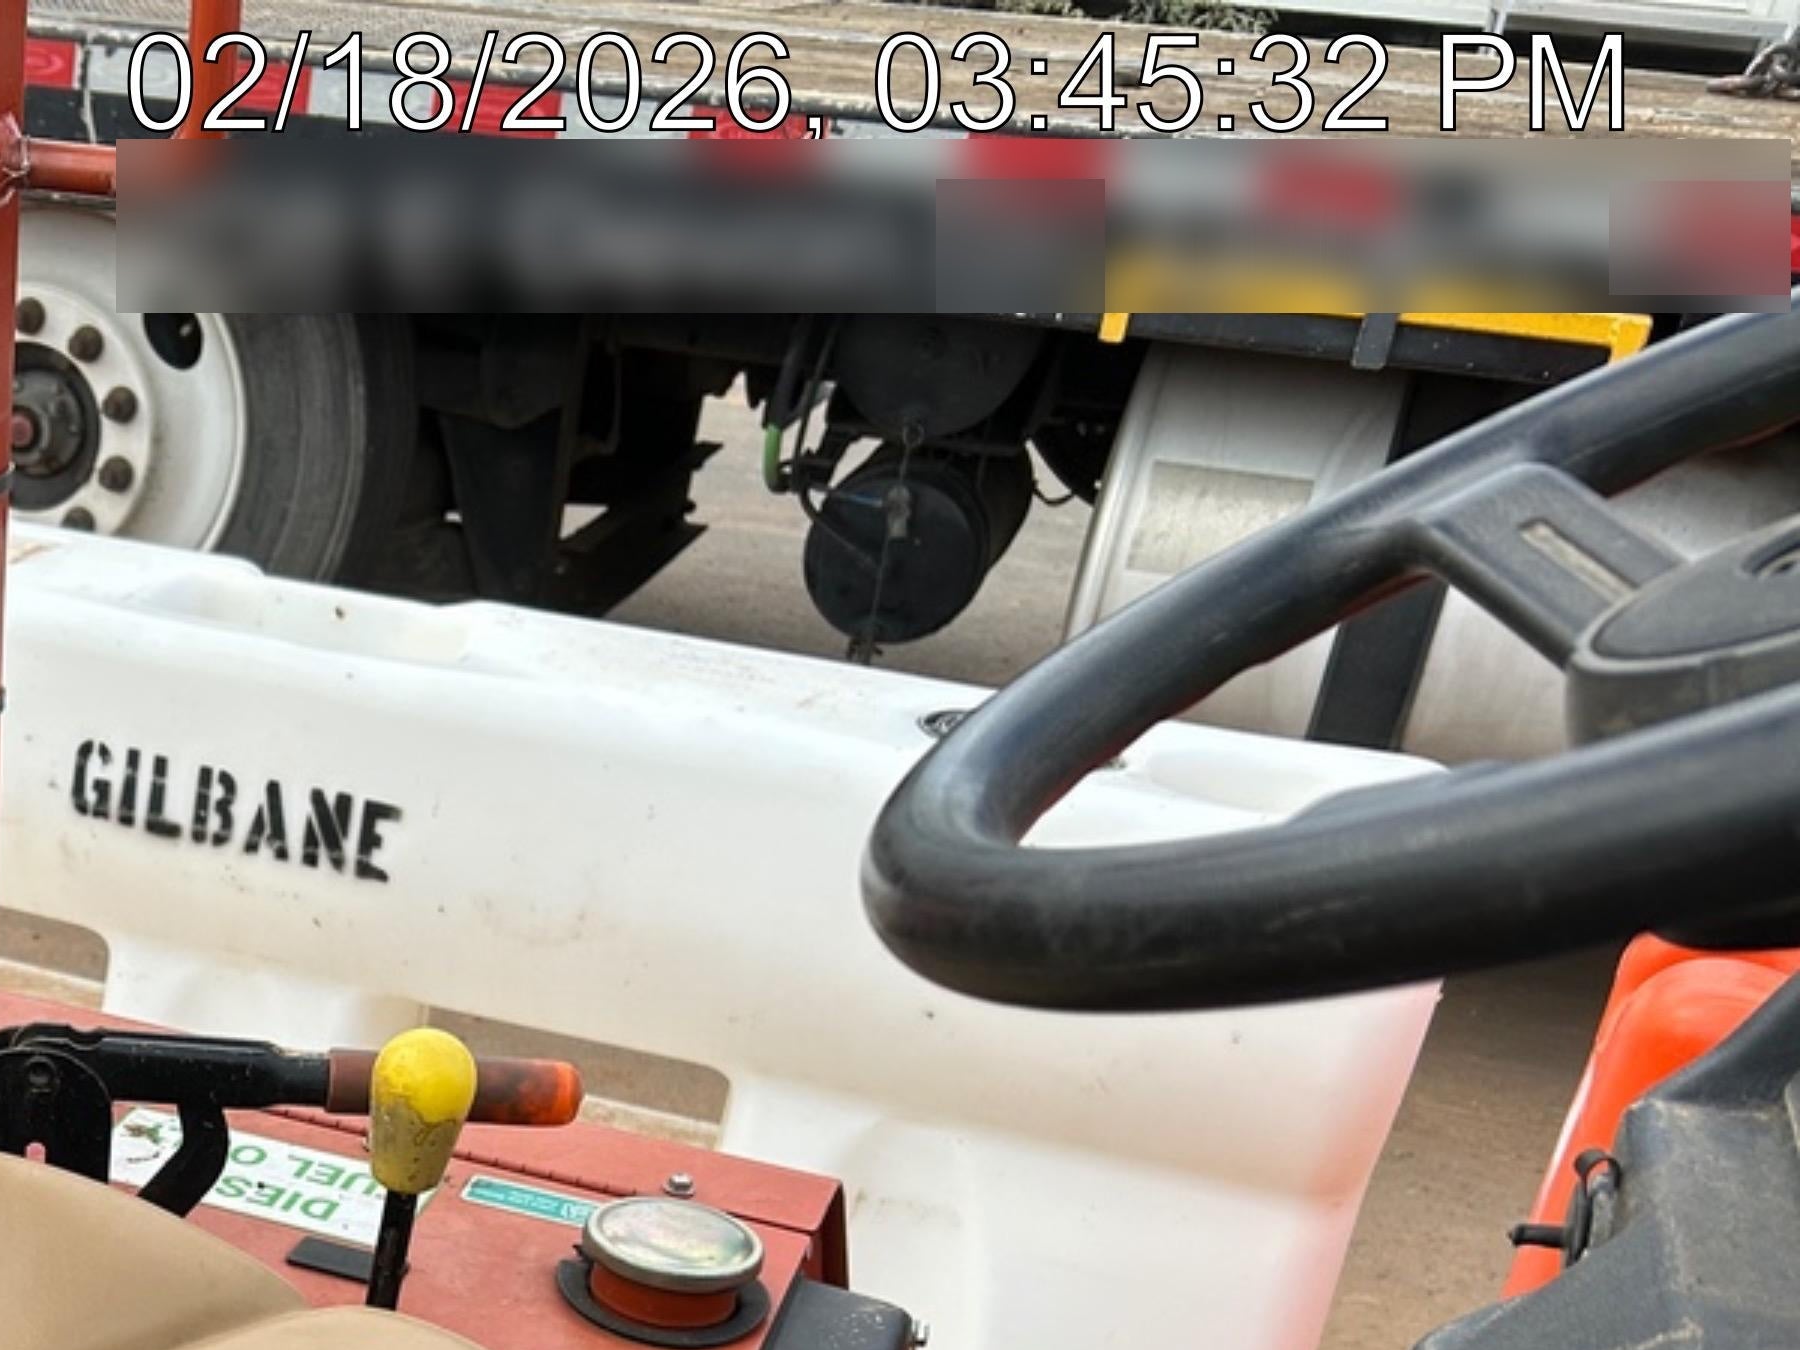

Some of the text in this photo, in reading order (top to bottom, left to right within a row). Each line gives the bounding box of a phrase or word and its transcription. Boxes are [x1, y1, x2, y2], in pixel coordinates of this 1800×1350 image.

[72, 739, 403, 883] GILBANE
[214, 1175, 340, 1222] DIES
[288, 1153, 383, 1197] UEL
